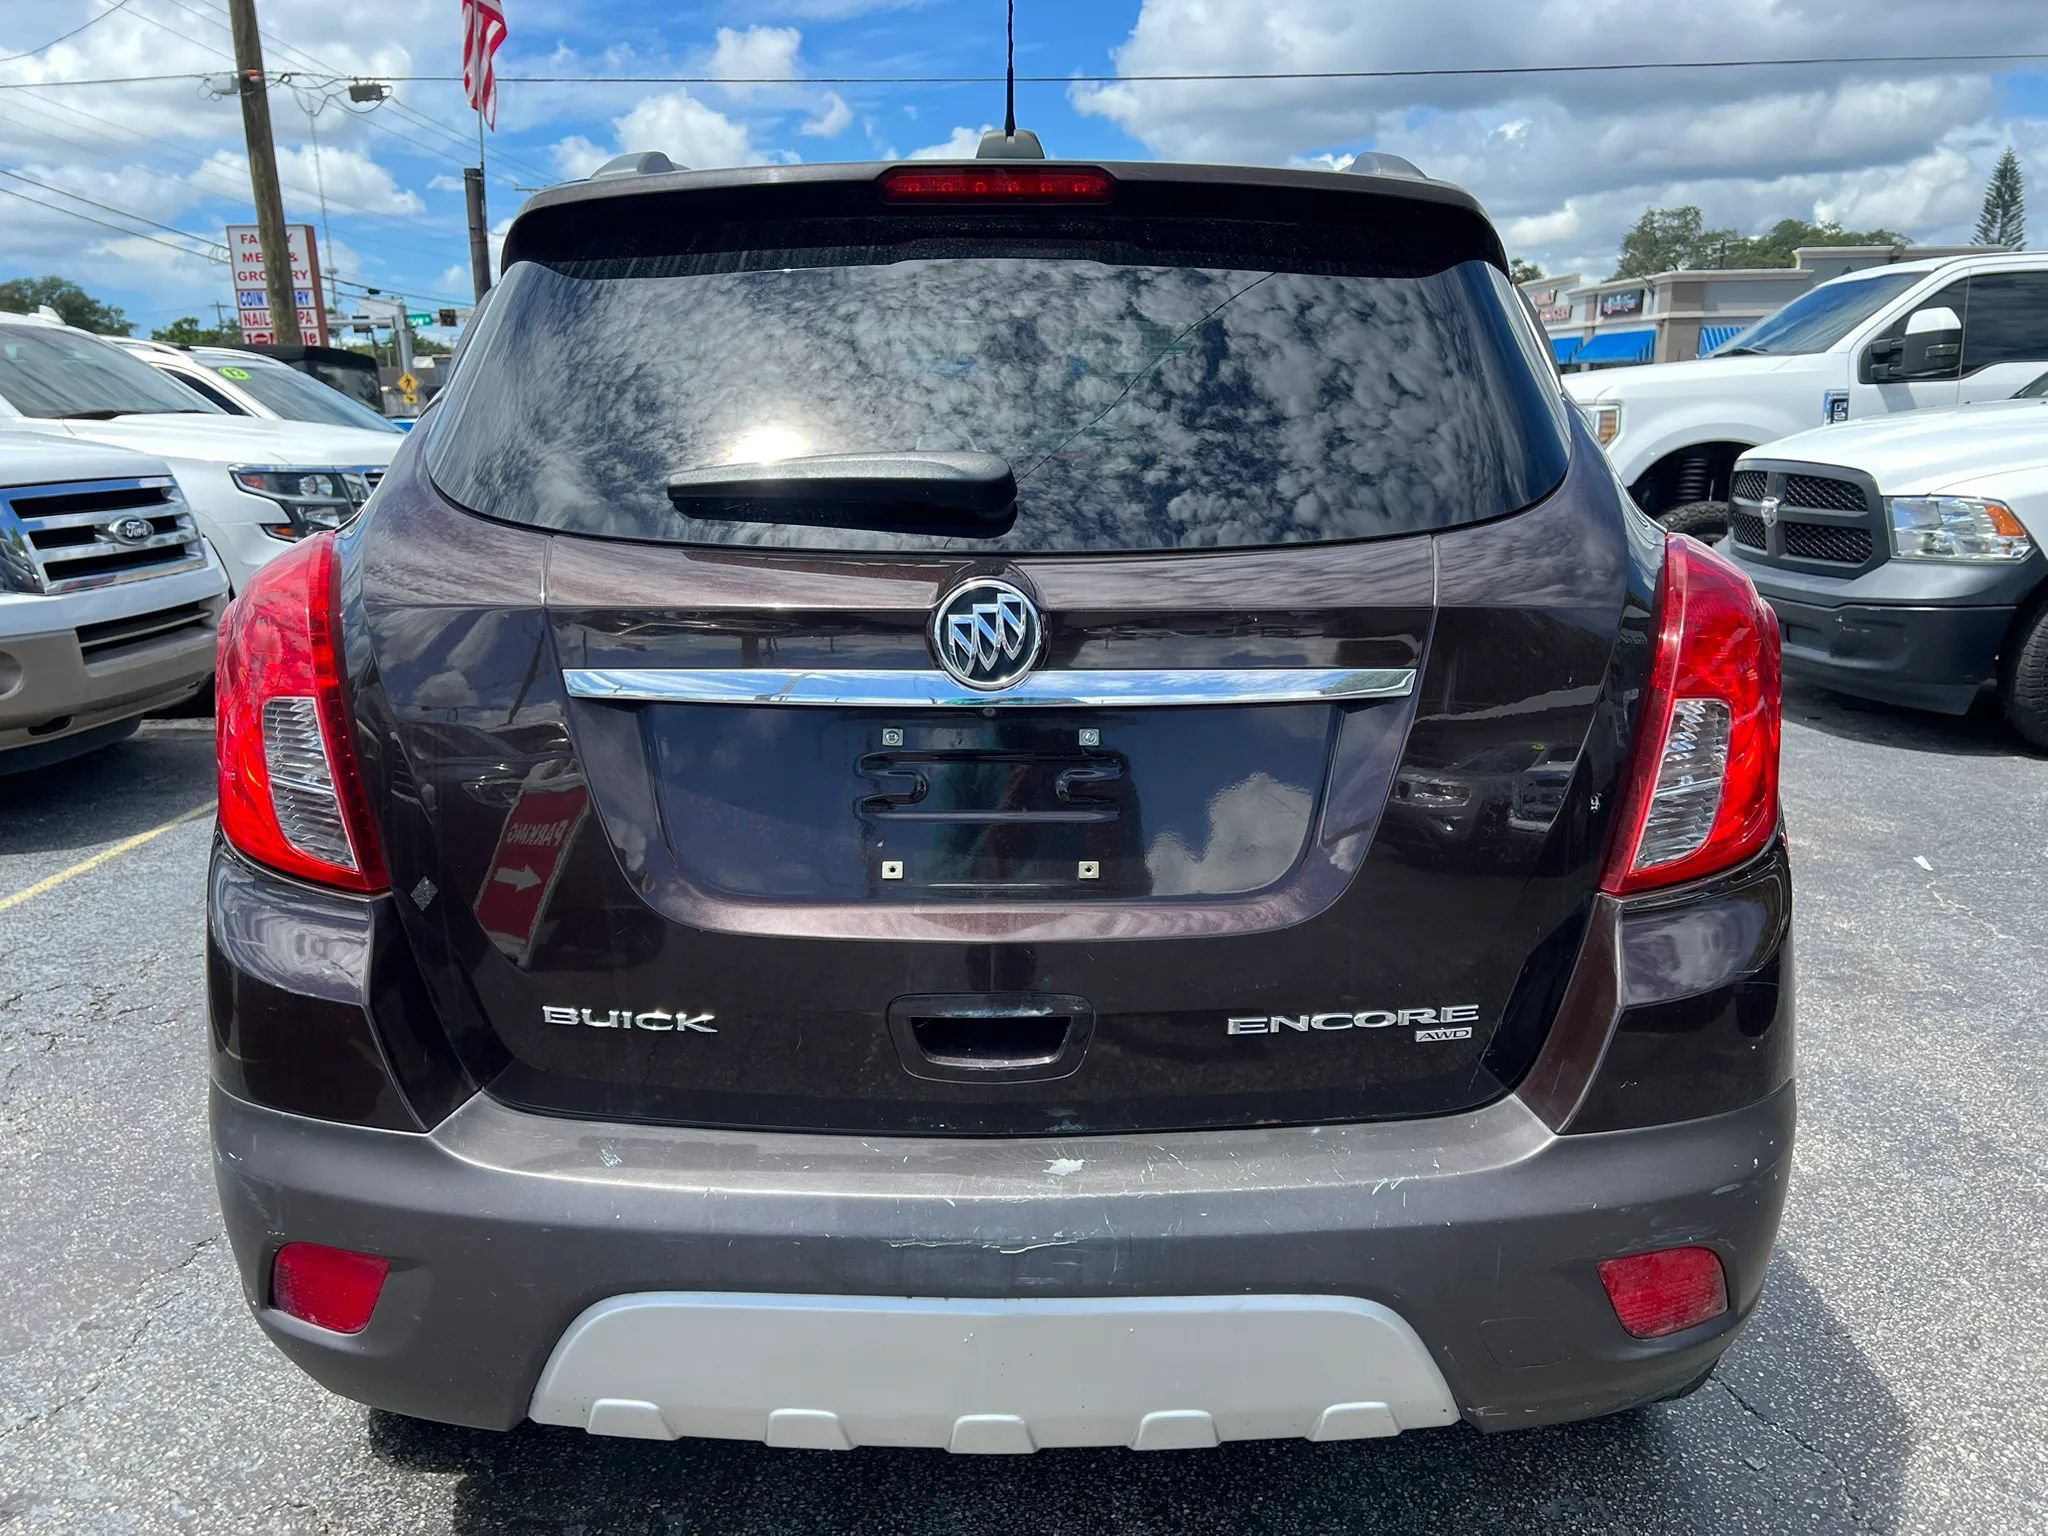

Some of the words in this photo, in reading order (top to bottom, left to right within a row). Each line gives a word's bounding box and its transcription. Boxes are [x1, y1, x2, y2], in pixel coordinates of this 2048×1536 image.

[240, 233, 293, 245] FAY
[237, 270, 309, 281] GRORY
[240, 291, 265, 307] COIN
[243, 311, 273, 326] NAIL
[297, 310, 314, 325] PA
[126, 521, 148, 538] Ford
[542, 1005, 718, 1033] BUICK
[1227, 1004, 1479, 1035] ENCORE
[1418, 1029, 1470, 1041] AWD
